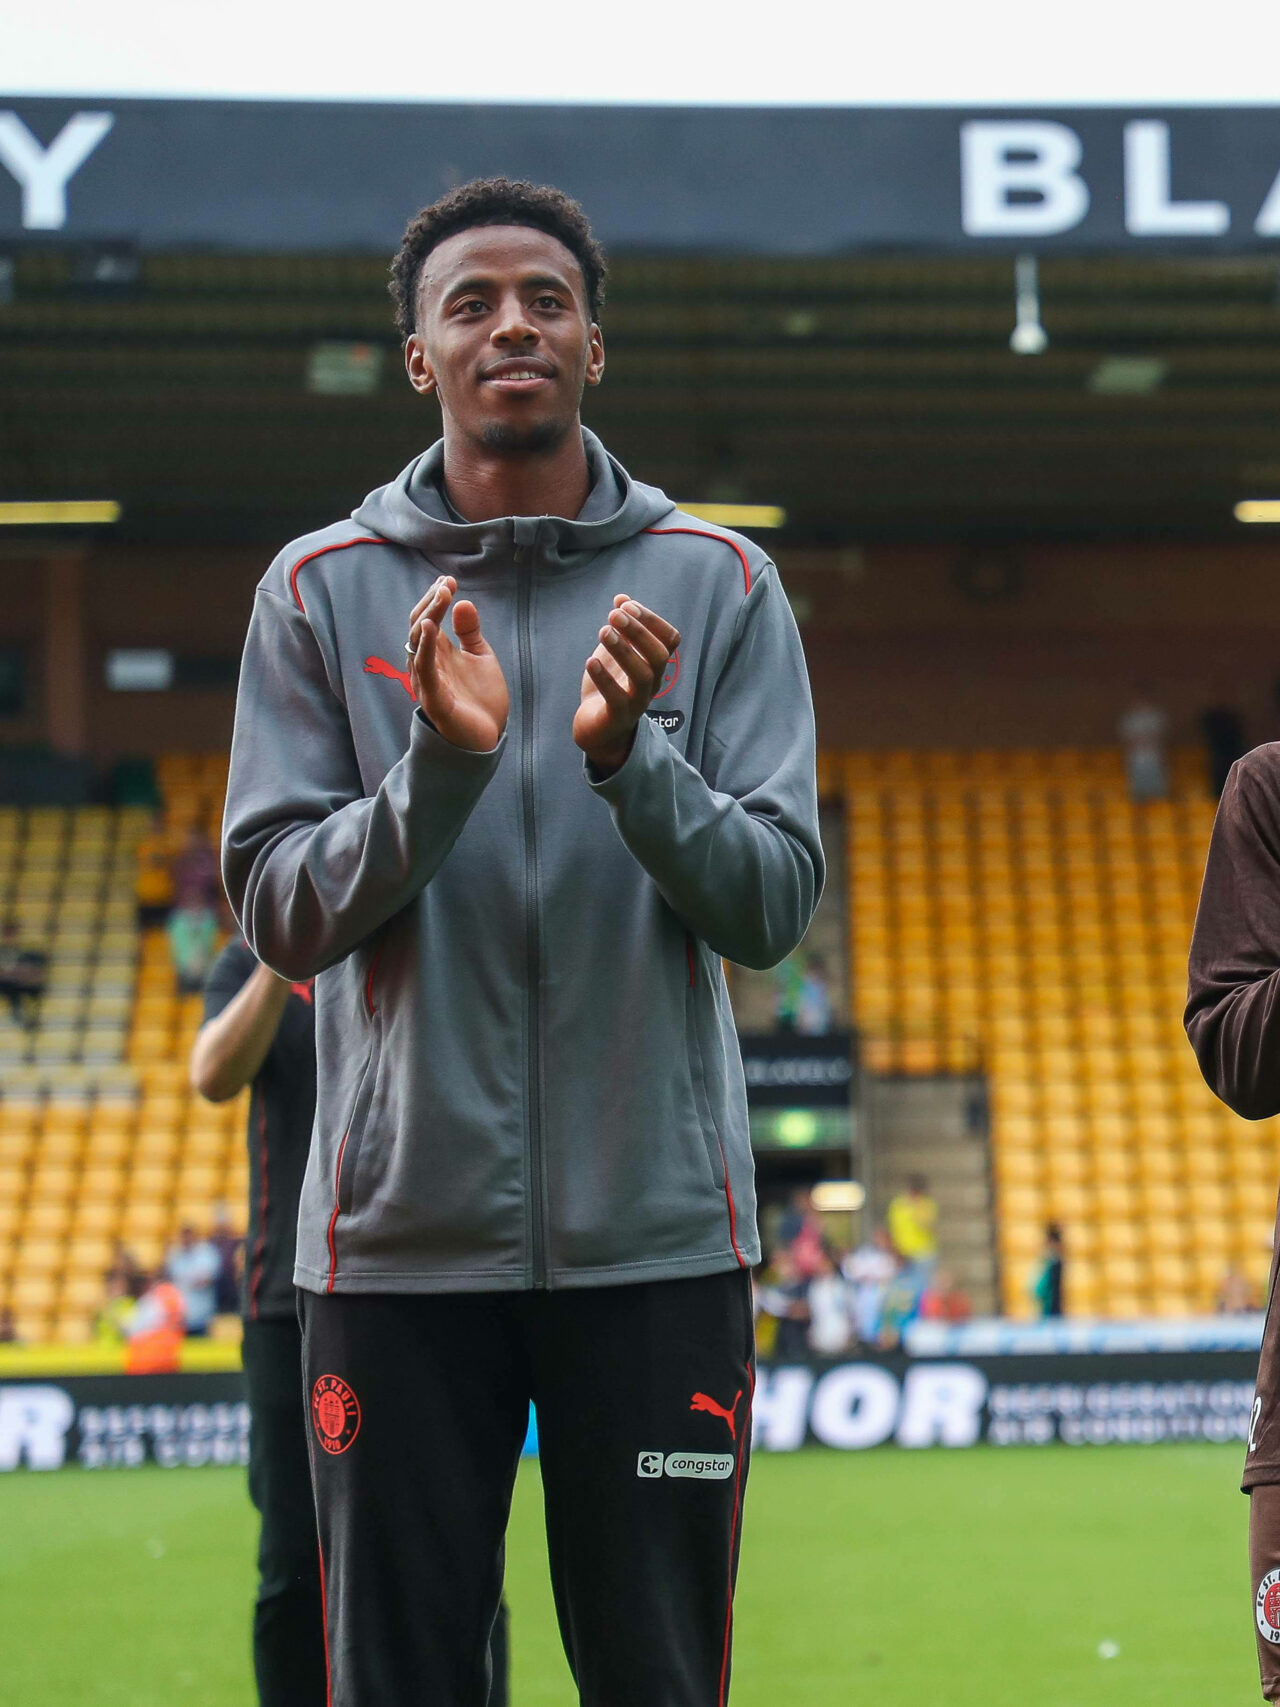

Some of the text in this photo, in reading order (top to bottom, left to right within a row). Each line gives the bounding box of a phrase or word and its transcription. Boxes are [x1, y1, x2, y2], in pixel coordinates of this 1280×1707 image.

[330, 1379, 357, 1416] PAULI
[324, 1436, 342, 1450] 1910
[672, 1459, 730, 1473] congstar
[1257, 1592, 1264, 1607] FC
[1263, 1575, 1275, 1589] ST.
